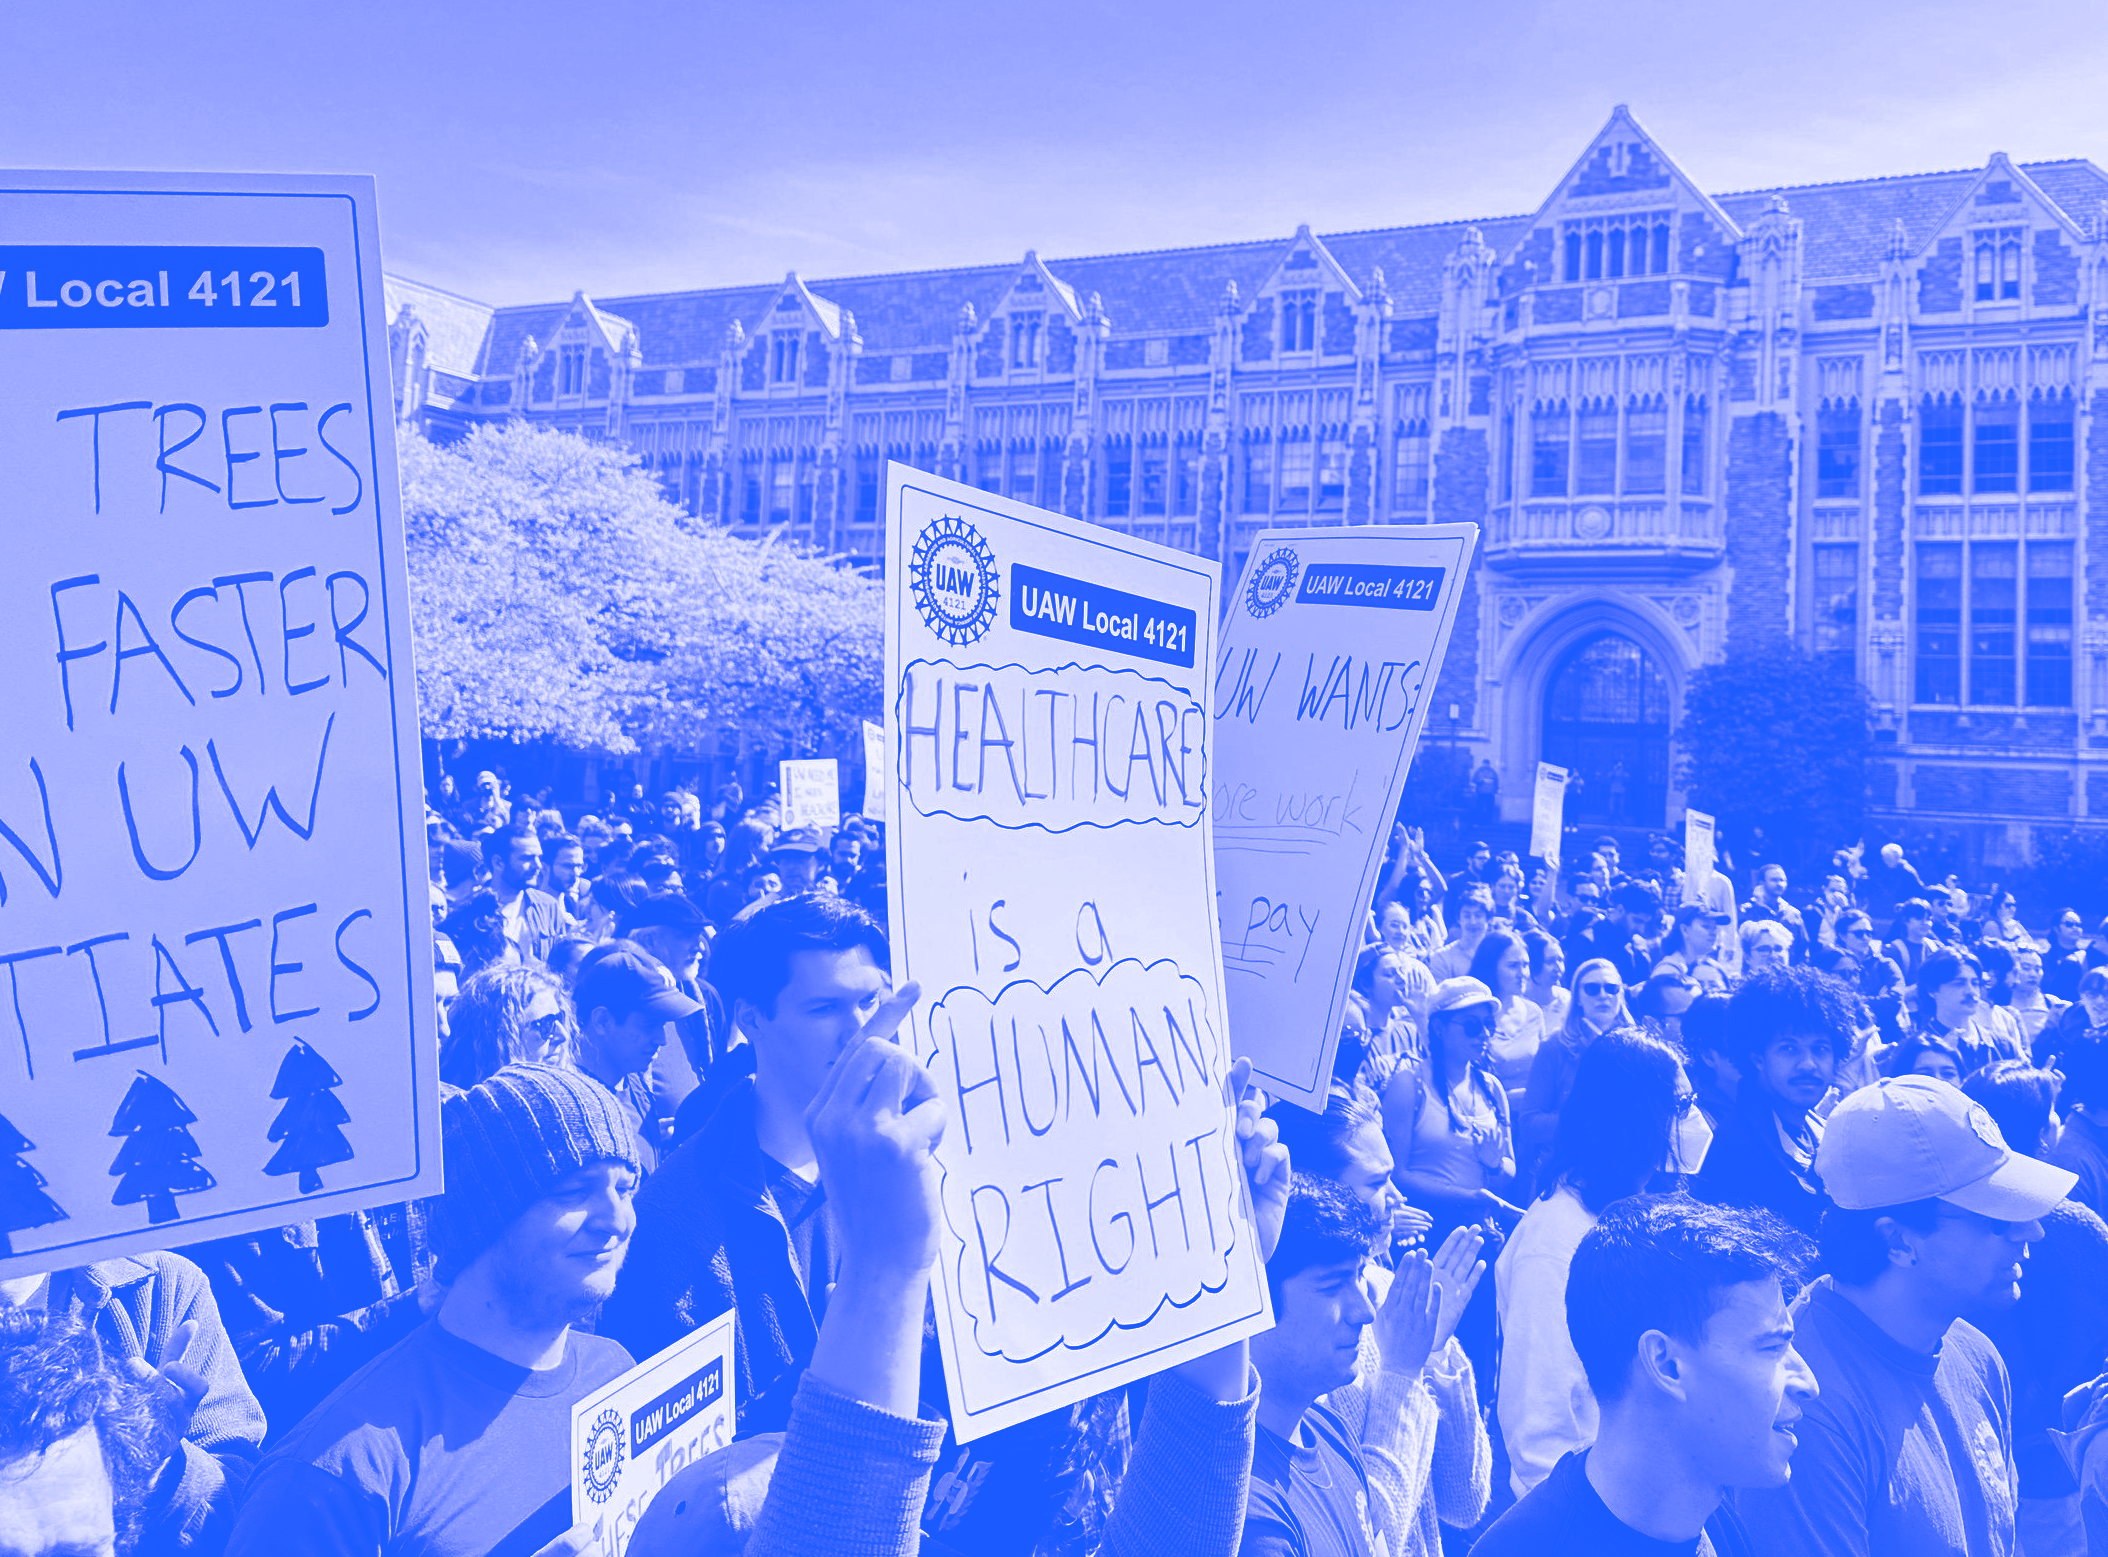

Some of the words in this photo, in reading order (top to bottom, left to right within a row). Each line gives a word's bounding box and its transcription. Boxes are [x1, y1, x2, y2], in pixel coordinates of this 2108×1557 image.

[26, 270, 170, 308] Local
[187, 270, 301, 307] 4121
[57, 401, 363, 516] TREES
[936, 563, 975, 598] UAW
[1021, 585, 1075, 627] UAW
[1083, 597, 1138, 642] Local
[1143, 618, 1188, 653] 4121
[1260, 576, 1284, 591] UAW
[1306, 576, 1344, 595] UAW
[1346, 578, 1391, 598] Local
[1393, 580, 1434, 601] 4121
[51, 566, 387, 731] FASTER
[1213, 646, 1282, 724] UW
[1296, 652, 1421, 733] WANTS:
[905, 671, 1202, 808] HEALTHCARE
[118, 711, 335, 881] UW
[1212, 779, 1257, 821] ore
[963, 871, 1021, 976] is
[1075, 899, 1113, 966] a
[1241, 896, 1320, 984] pay
[0, 903, 381, 1080] TIATES
[947, 997, 1210, 1155] HUMAN
[970, 1128, 1217, 1324] RIGHT
[635, 1406, 663, 1445] UAW
[666, 1385, 695, 1422] Local
[696, 1369, 719, 1402] 4121
[594, 1441, 613, 1471] UAW
